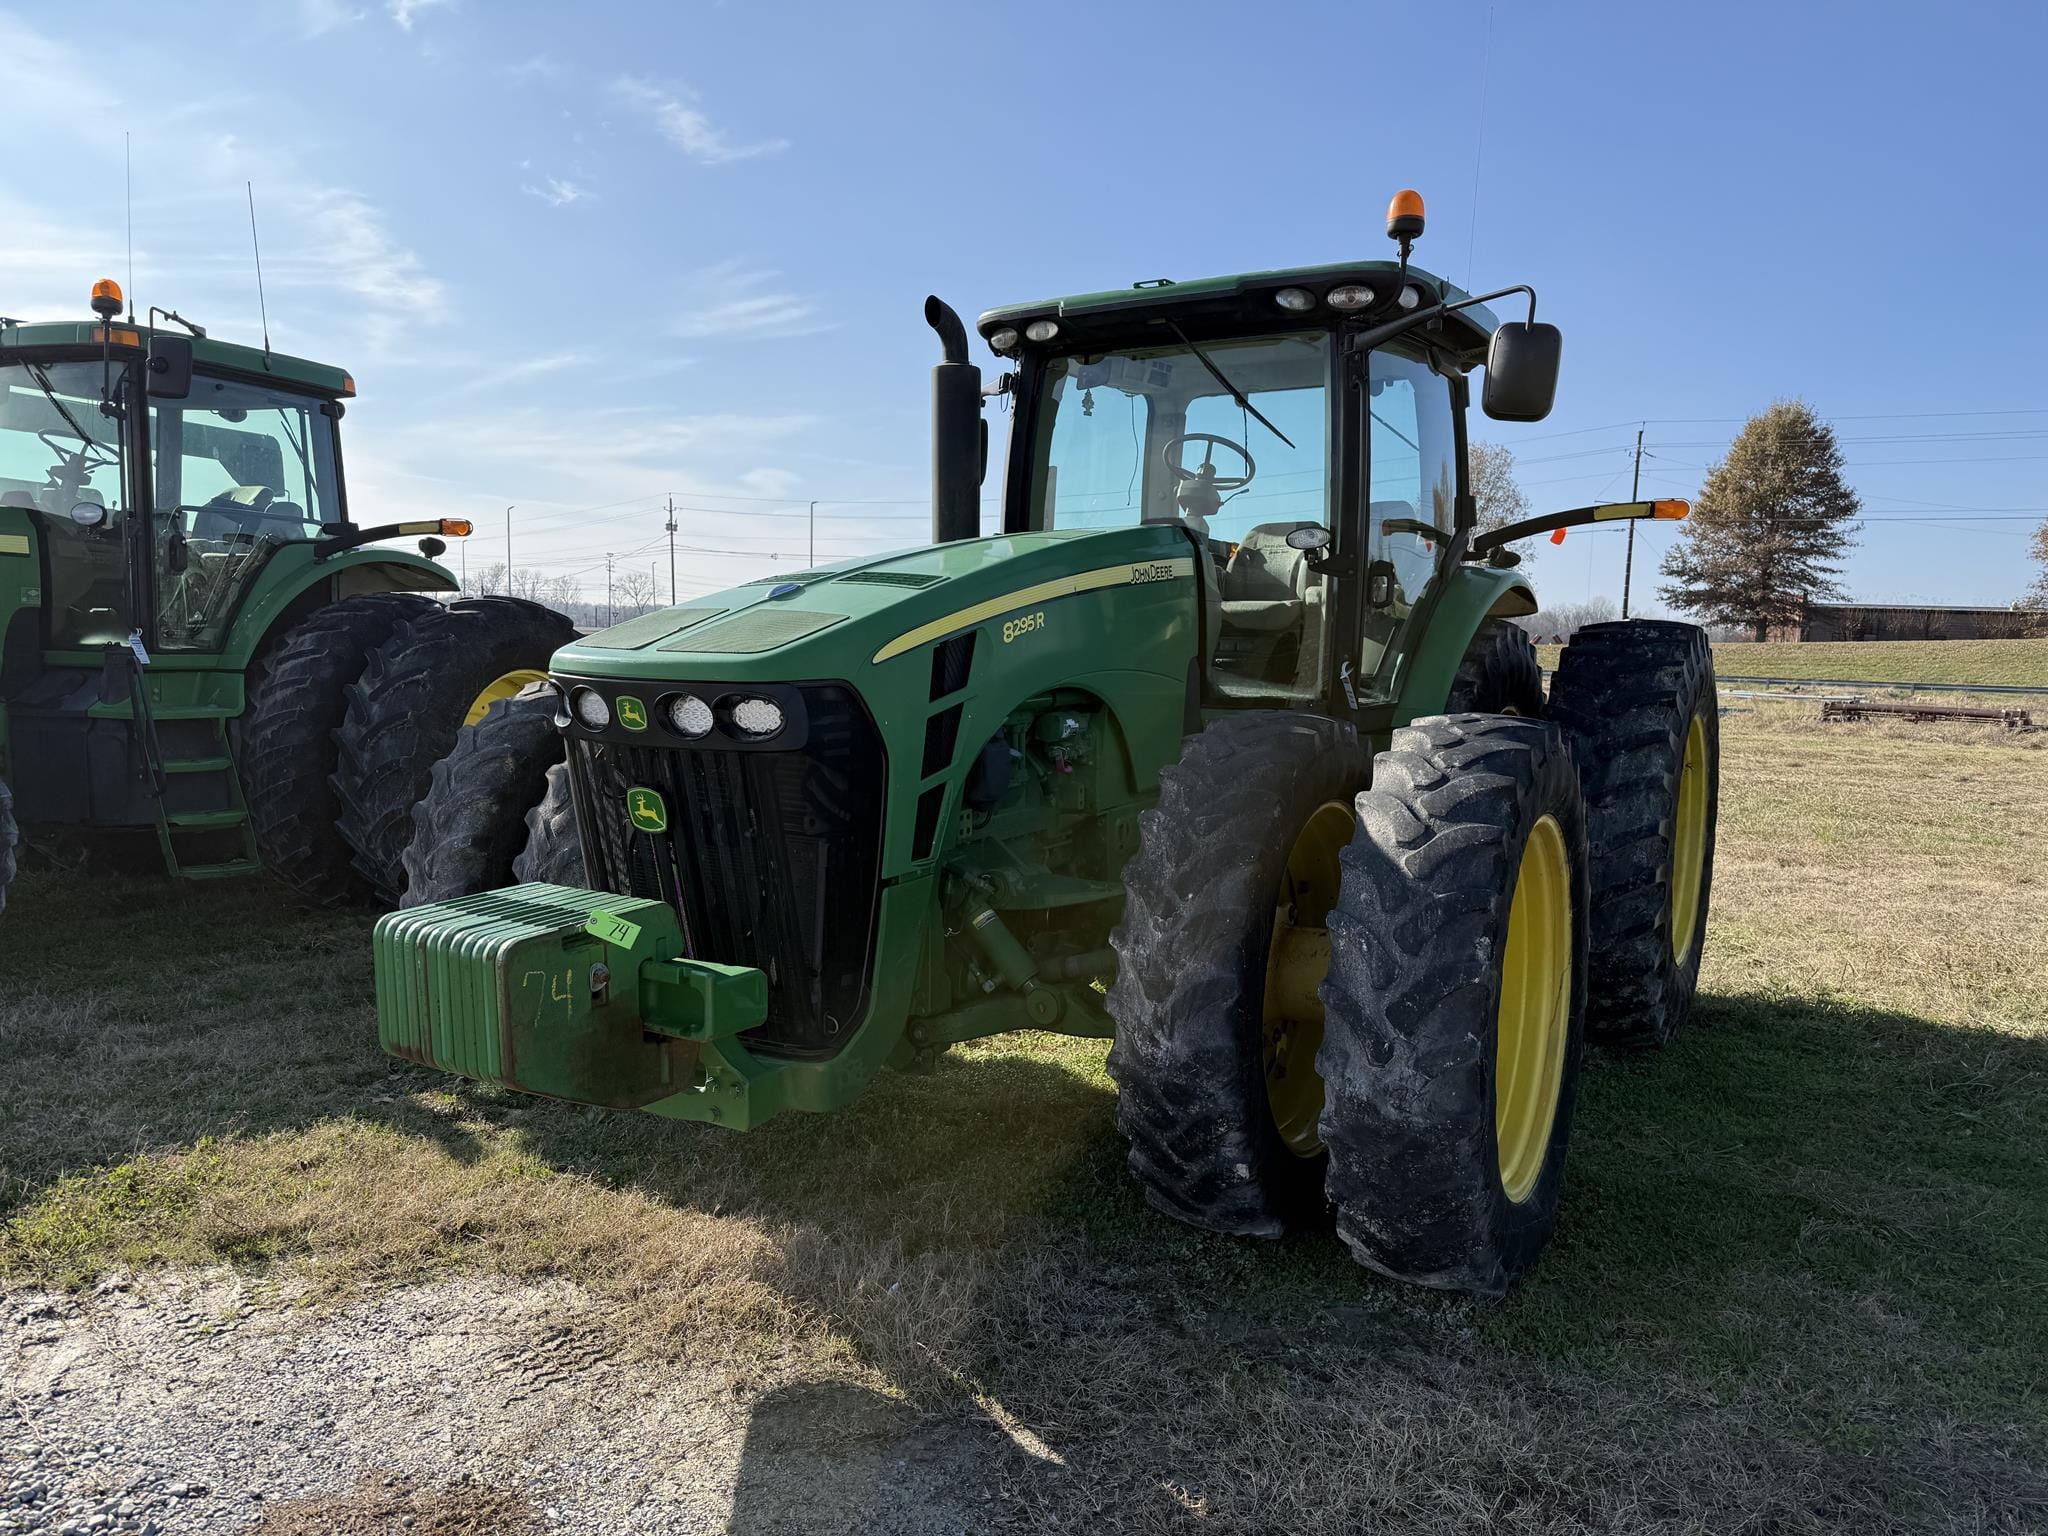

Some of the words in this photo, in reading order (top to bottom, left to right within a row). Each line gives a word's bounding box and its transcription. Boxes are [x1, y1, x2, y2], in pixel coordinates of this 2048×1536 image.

[1003, 611, 1044, 643] 8295R
[607, 920, 631, 942] 74
[522, 968, 574, 1029] 74
